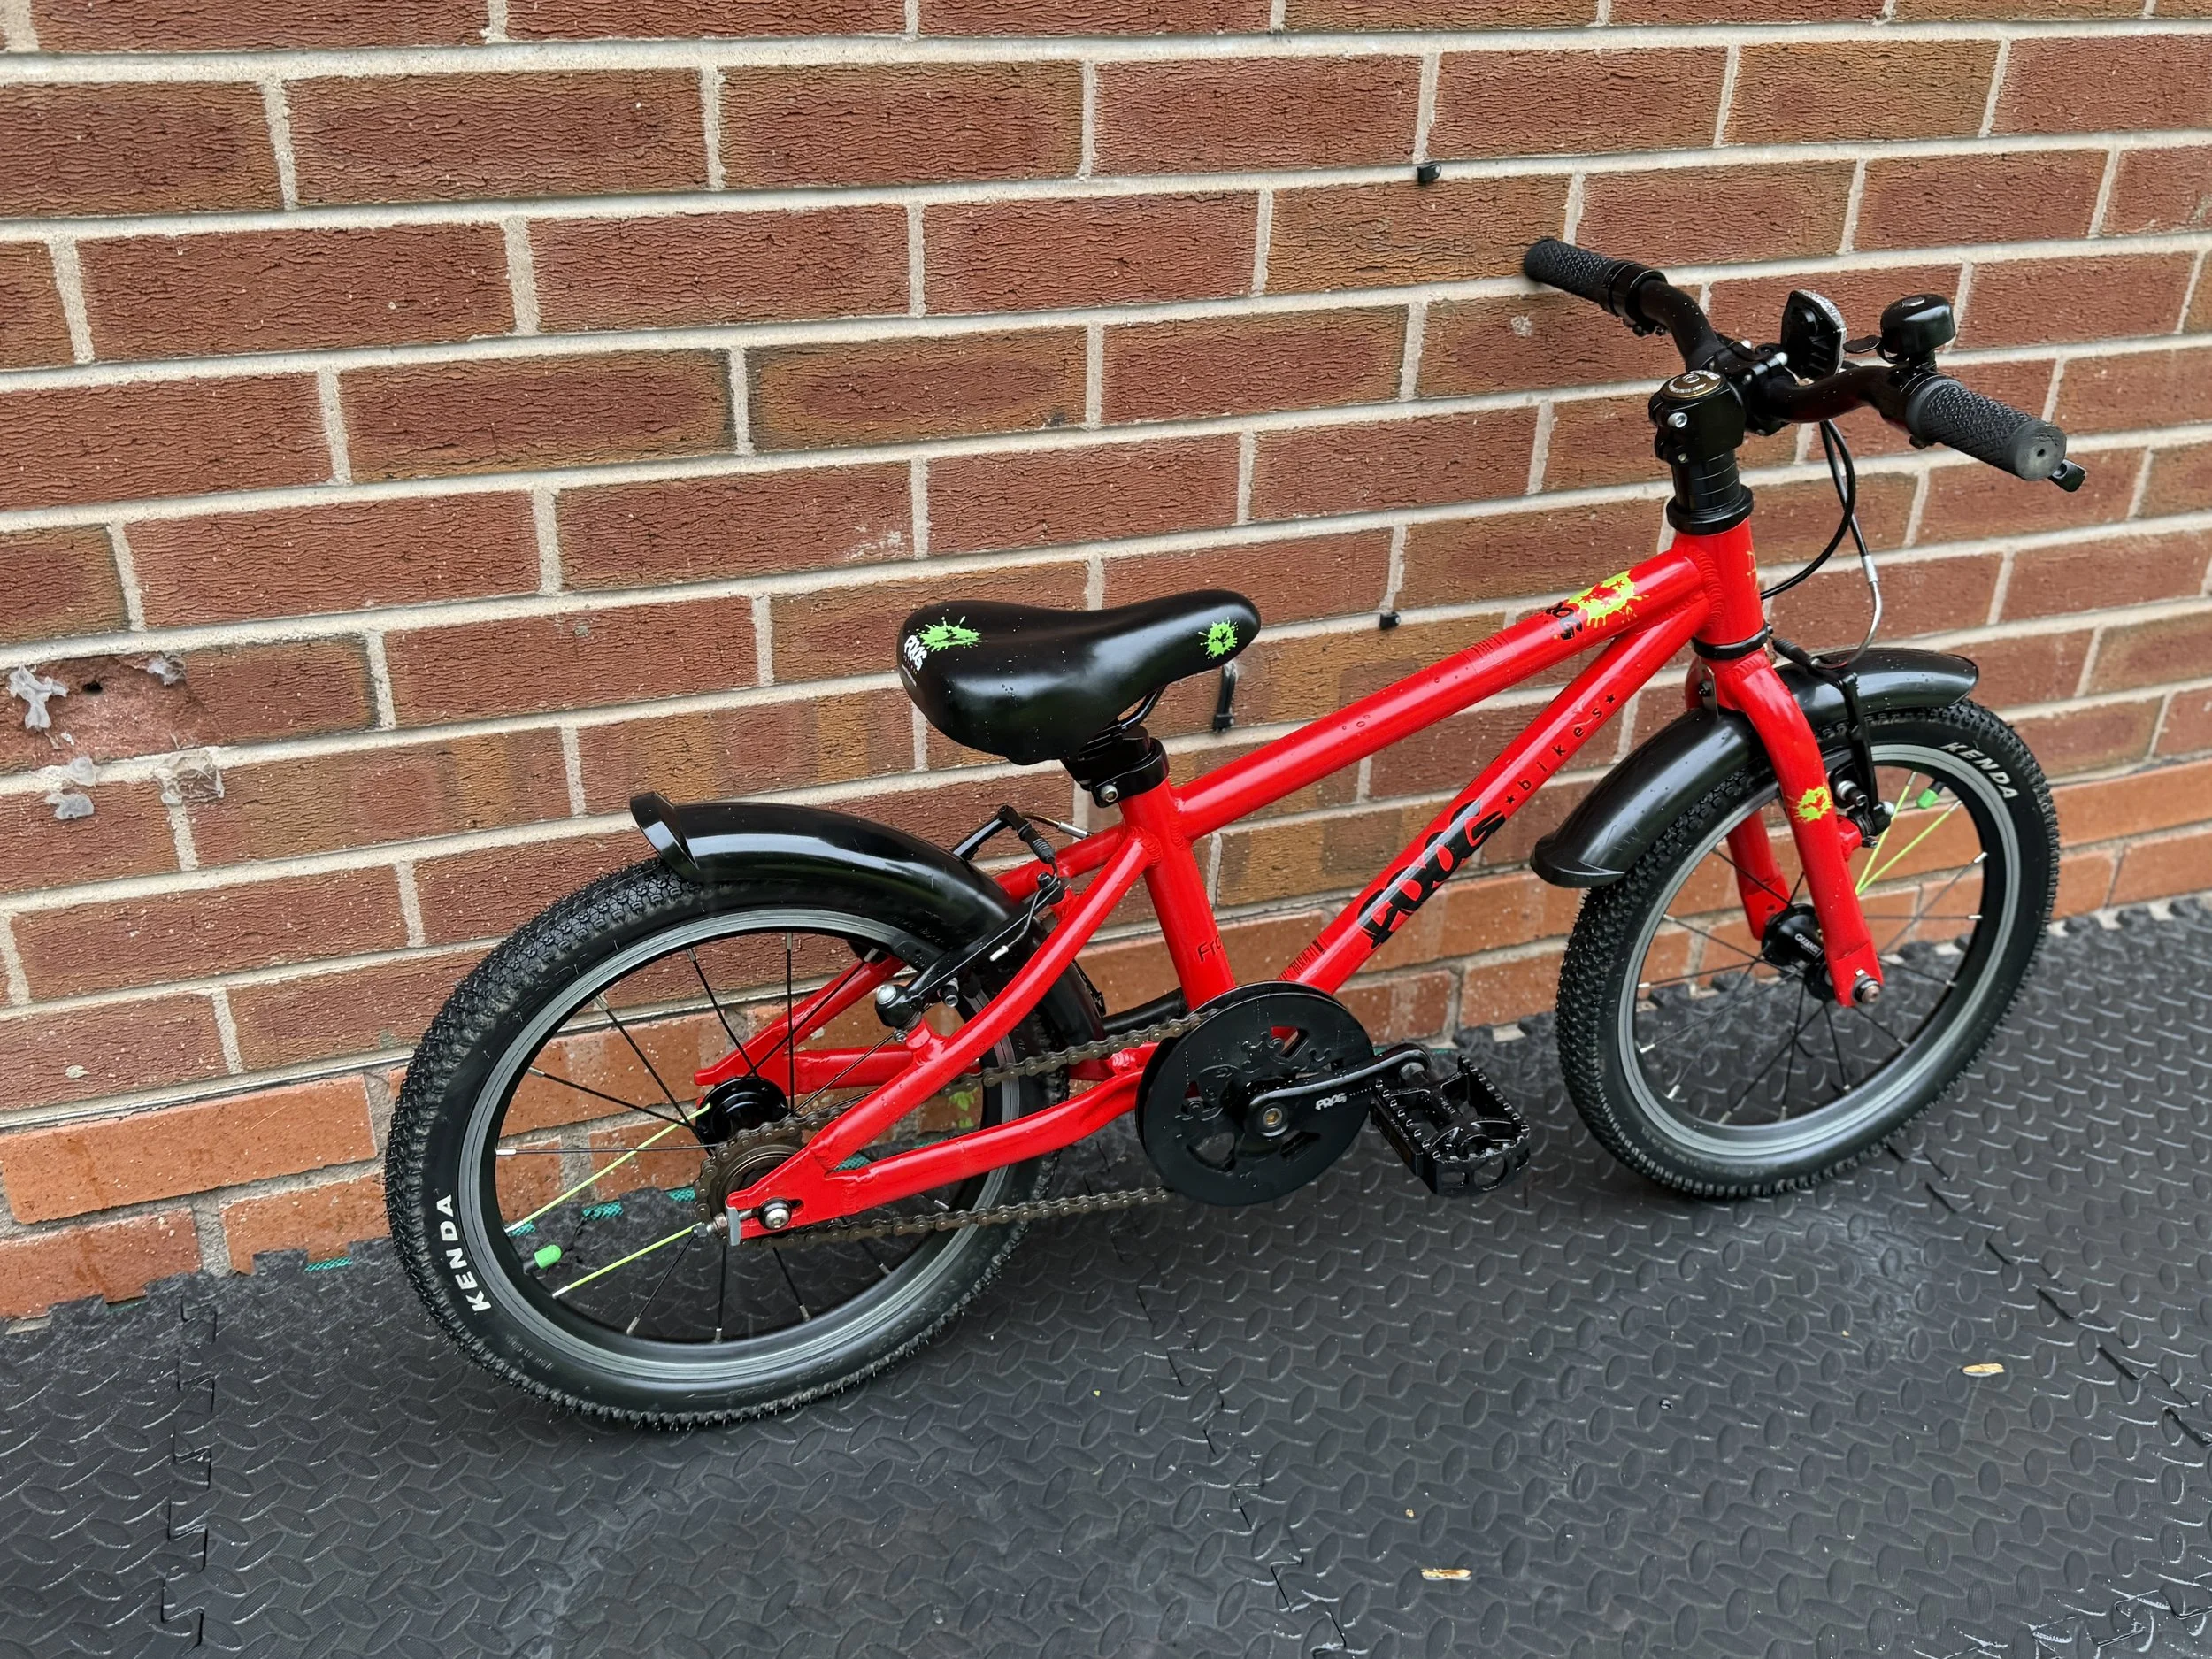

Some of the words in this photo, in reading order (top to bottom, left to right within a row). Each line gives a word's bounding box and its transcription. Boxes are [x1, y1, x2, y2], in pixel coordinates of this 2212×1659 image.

[1517, 707, 1603, 791] bikes
[1939, 741, 2019, 799] KENDA
[436, 1194, 492, 1312] KENDA
